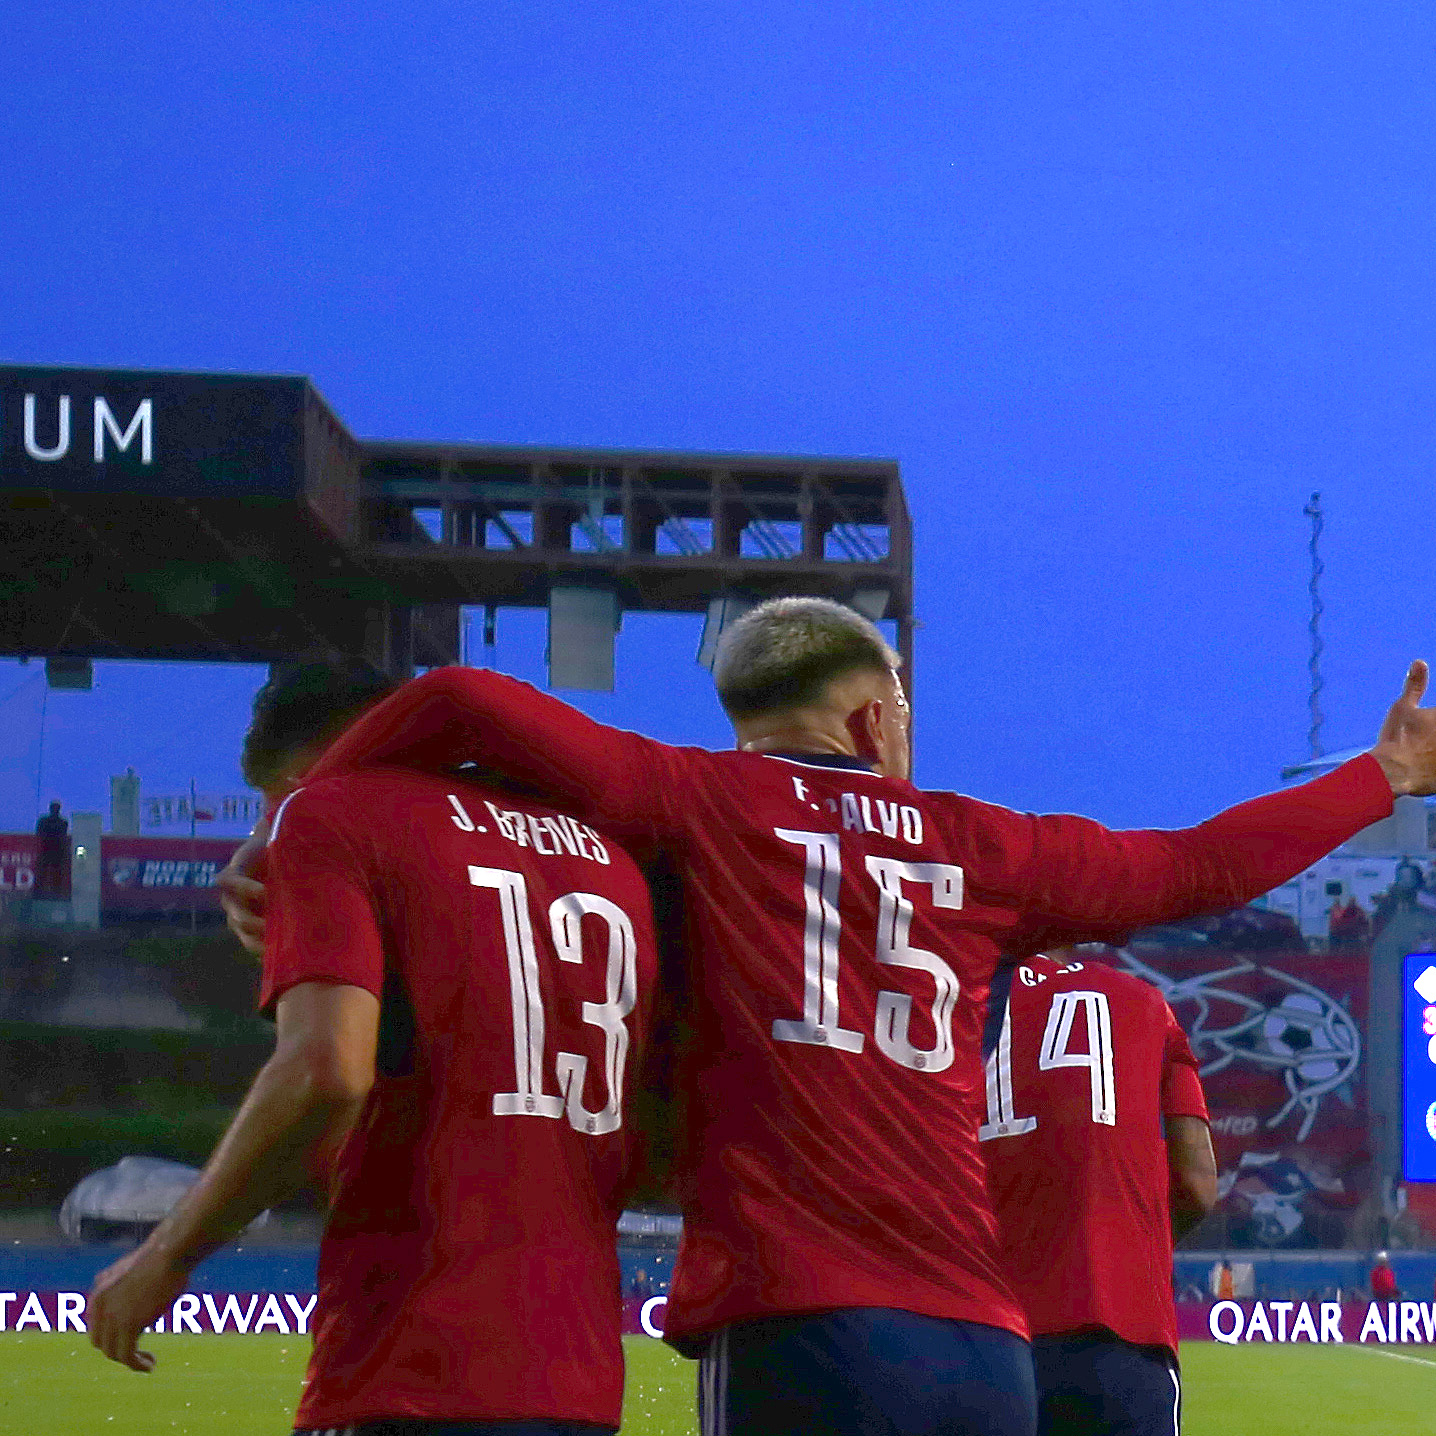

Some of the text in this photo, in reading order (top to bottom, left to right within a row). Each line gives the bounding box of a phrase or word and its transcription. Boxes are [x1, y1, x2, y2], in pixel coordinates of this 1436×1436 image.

[24, 393, 152, 465] UM
[448, 795, 611, 866] J. BRENES
[826, 792, 923, 845] ALVO
[772, 827, 964, 1073] 15
[467, 865, 638, 1136] 13
[978, 990, 1116, 1142] 14
[143, 1293, 318, 1335] RWAY
[1209, 1300, 1344, 1345] QATAR
